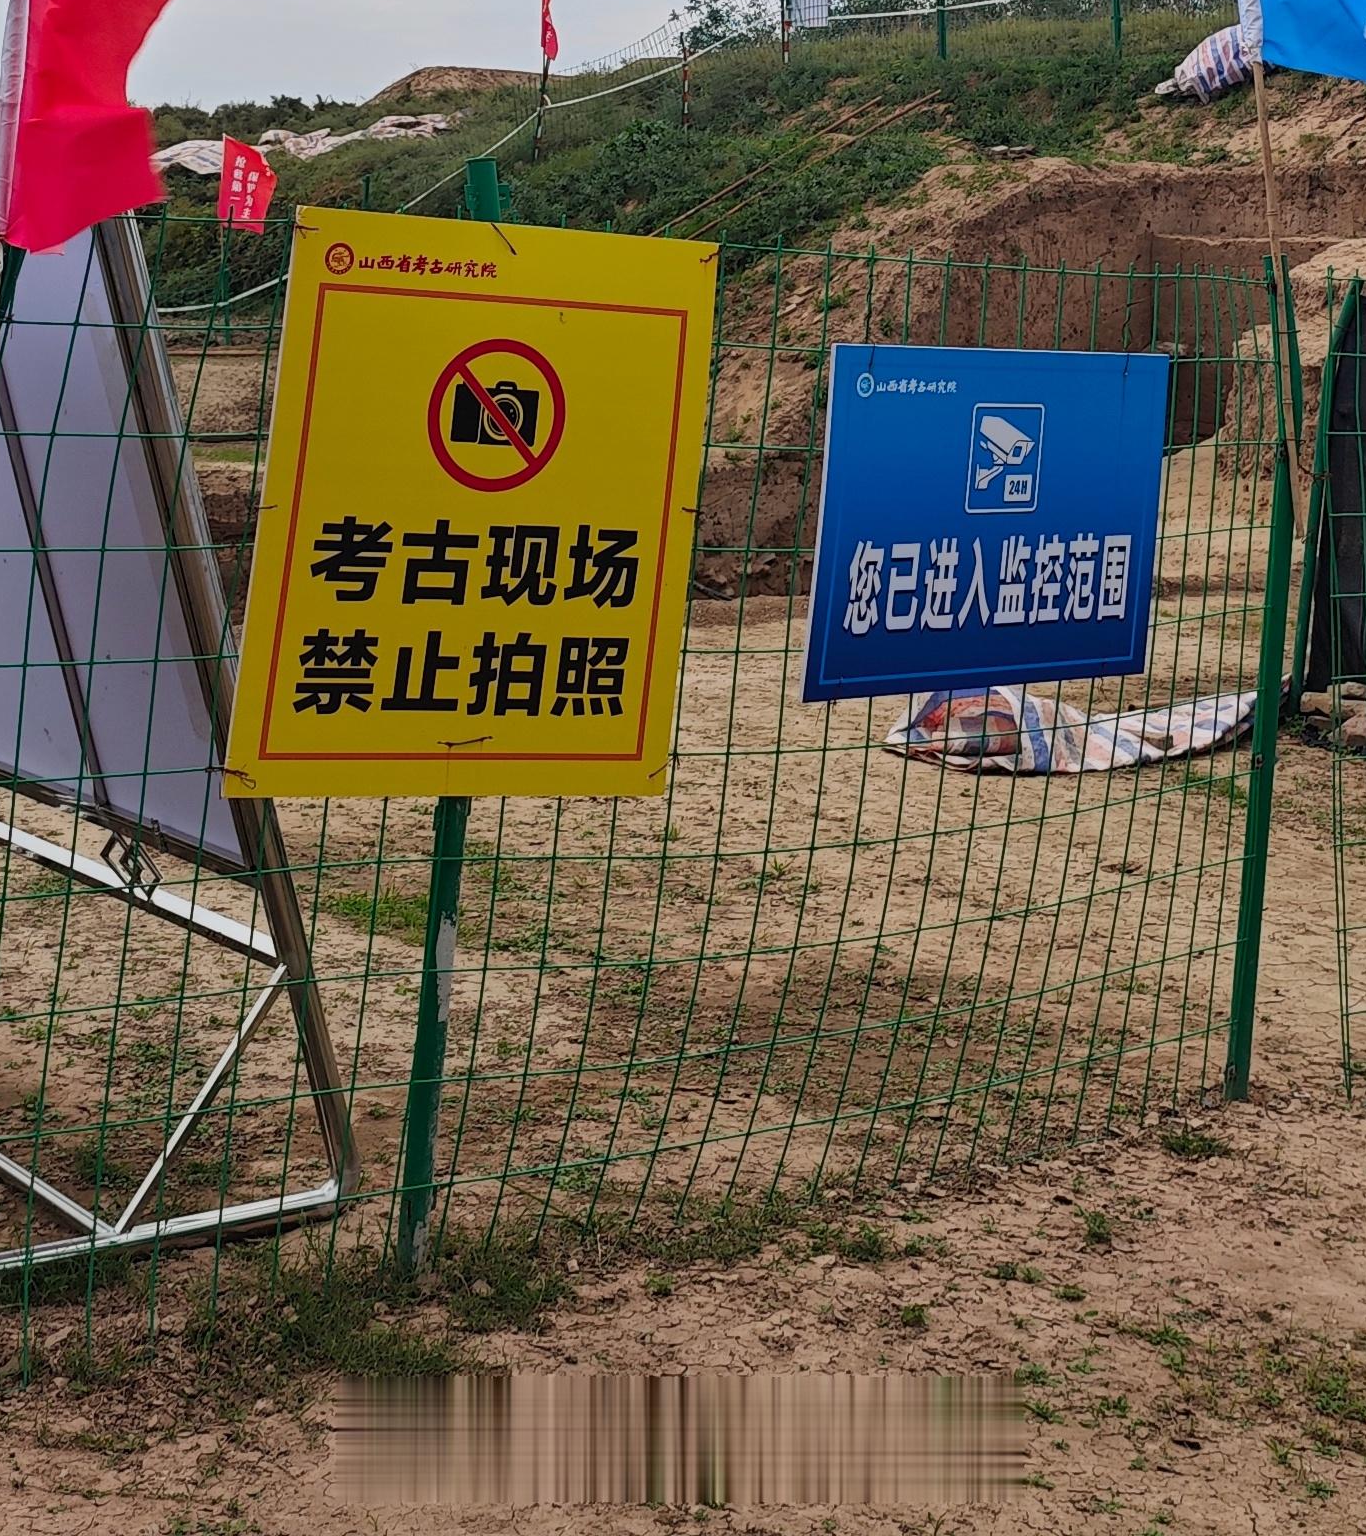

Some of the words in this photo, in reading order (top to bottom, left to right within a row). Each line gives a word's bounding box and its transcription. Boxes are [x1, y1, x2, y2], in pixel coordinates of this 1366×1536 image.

[358, 254, 498, 279] 山西省考古研究院
[1008, 479, 1028, 495] 24H
[309, 515, 641, 610] 考古现场
[843, 533, 1133, 635] 您已进入监控范围
[292, 627, 631, 718] 禁止拍照
